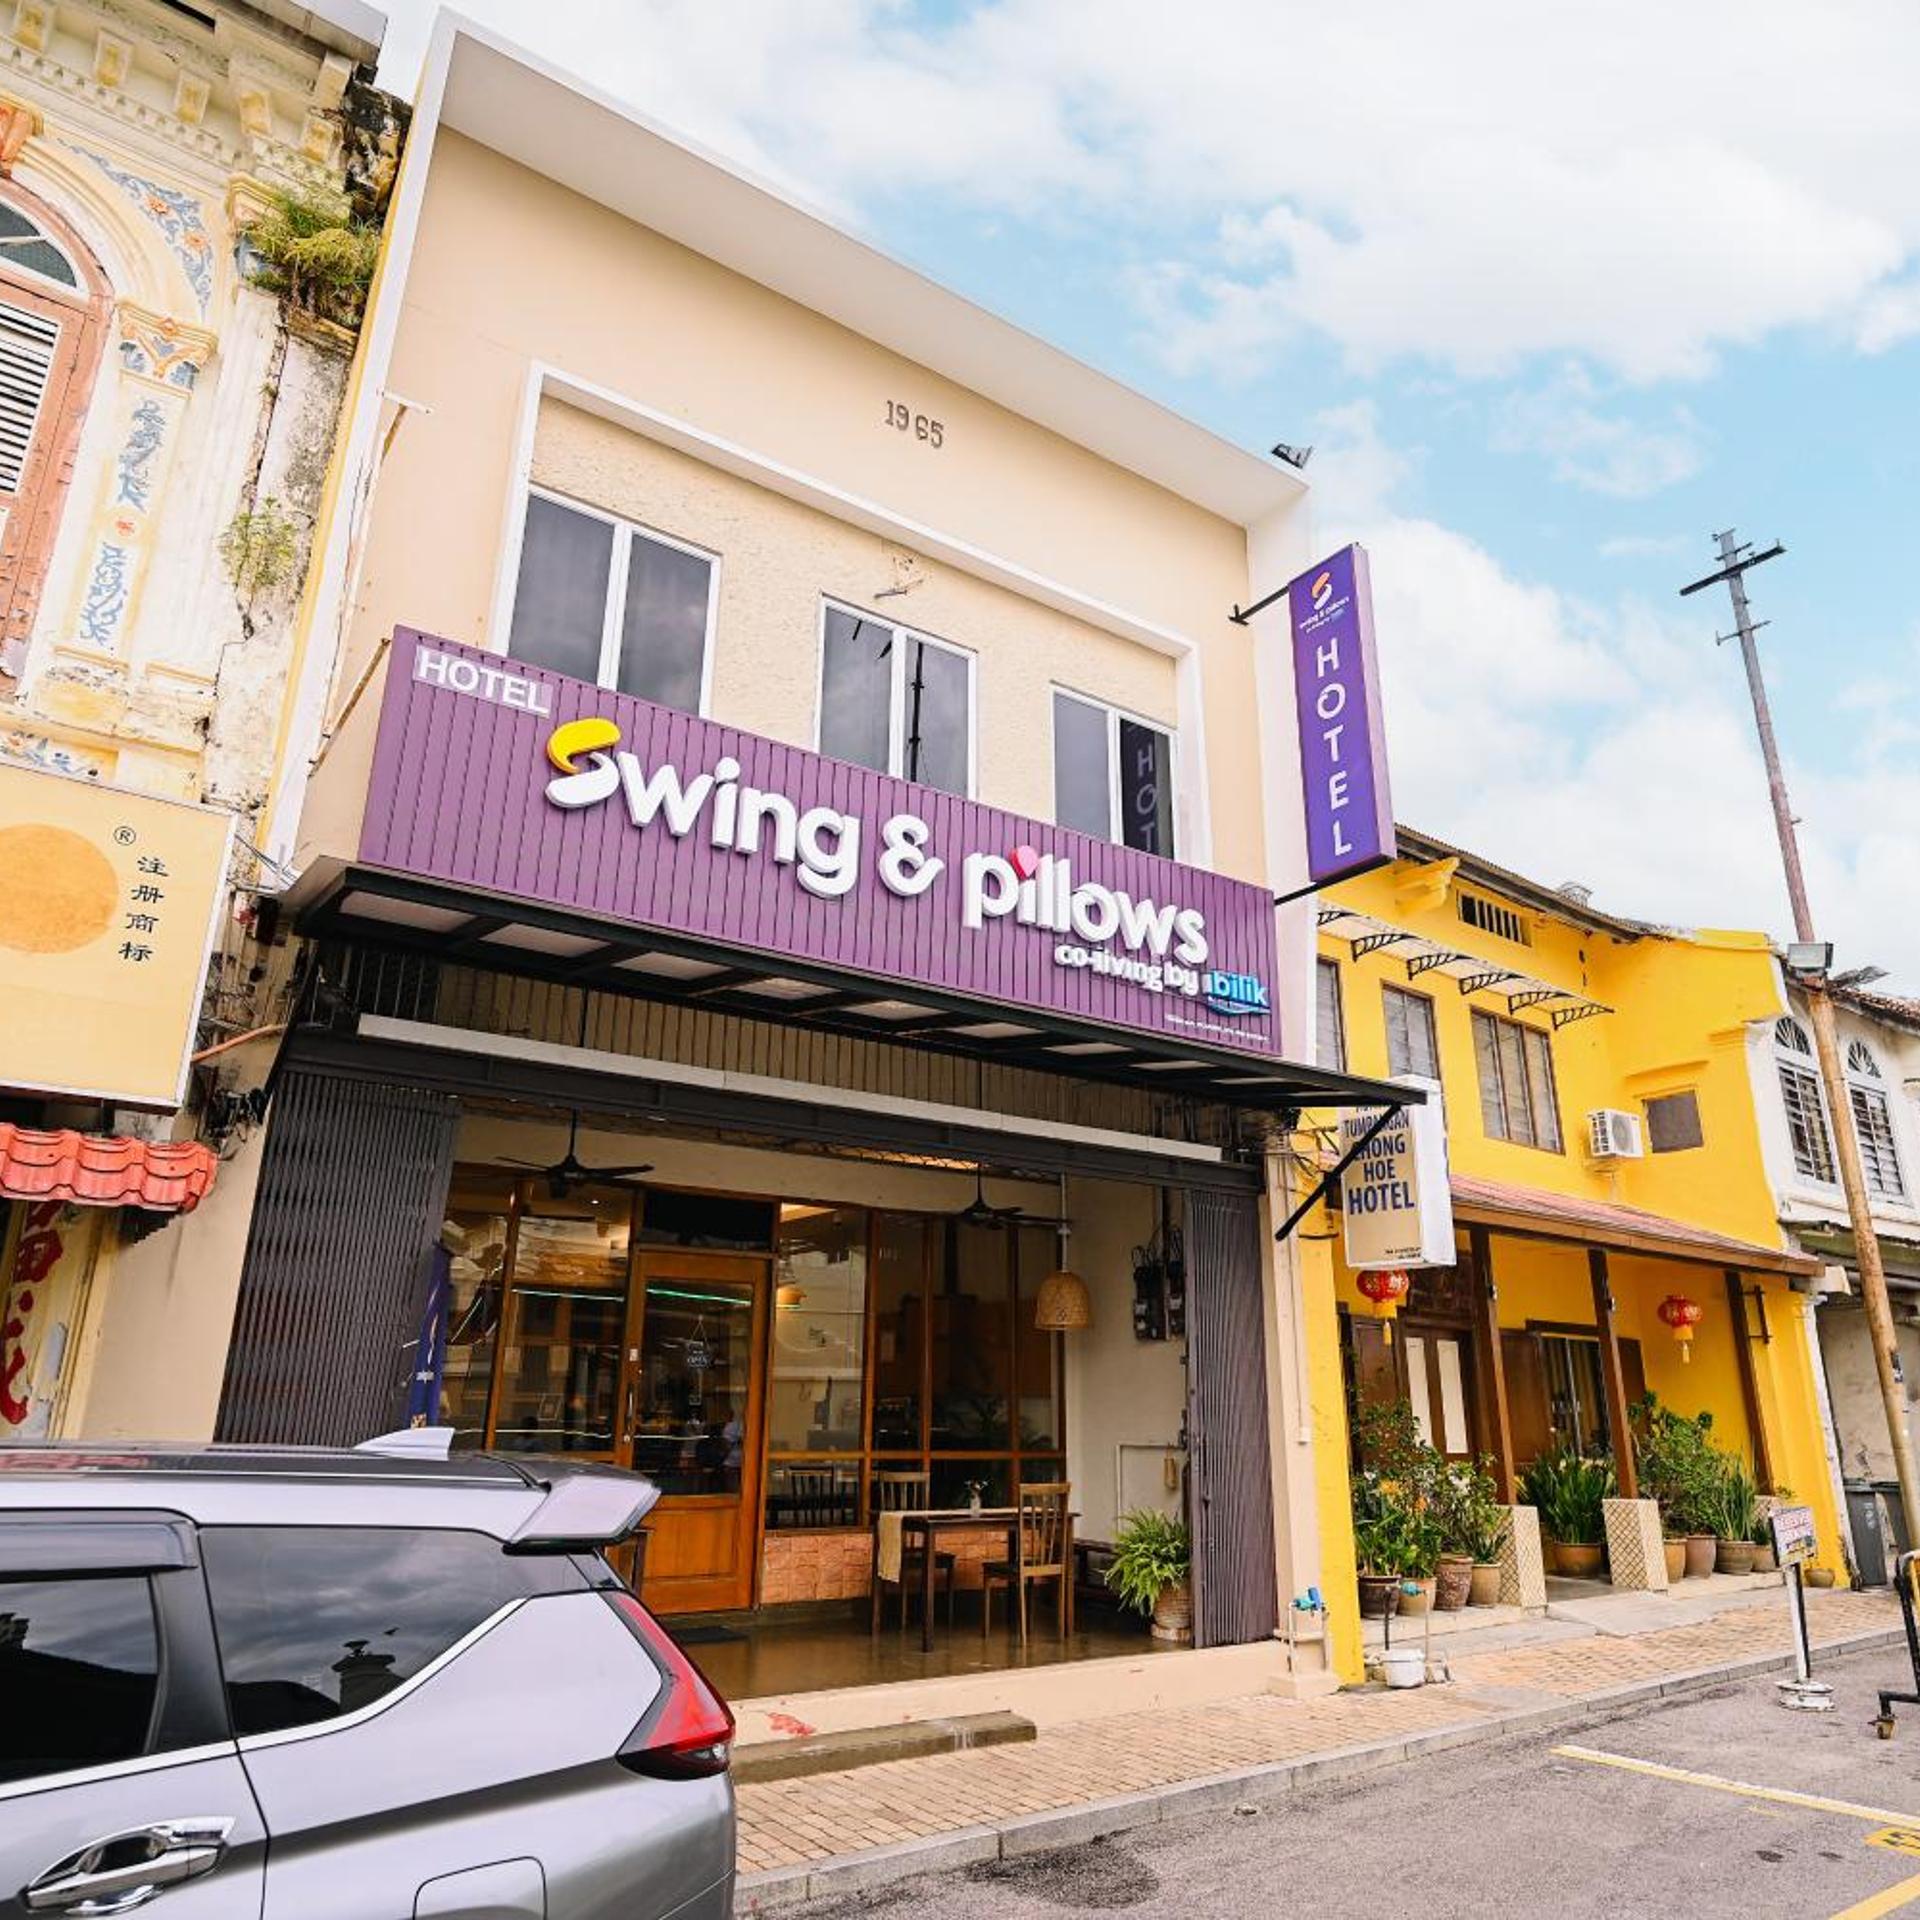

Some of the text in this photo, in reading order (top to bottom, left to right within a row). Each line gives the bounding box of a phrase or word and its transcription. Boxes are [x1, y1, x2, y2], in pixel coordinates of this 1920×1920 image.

[884, 399, 944, 448] 1965
[416, 648, 549, 715] HOTEL
[1315, 637, 1353, 857] HOTEL
[545, 717, 1210, 965] Swing & pillows
[118, 856, 169, 963] 注册商标
[1163, 960, 1199, 997] by
[1348, 1181, 1415, 1215] HOTEL
[1363, 1158, 1396, 1182] HOE
